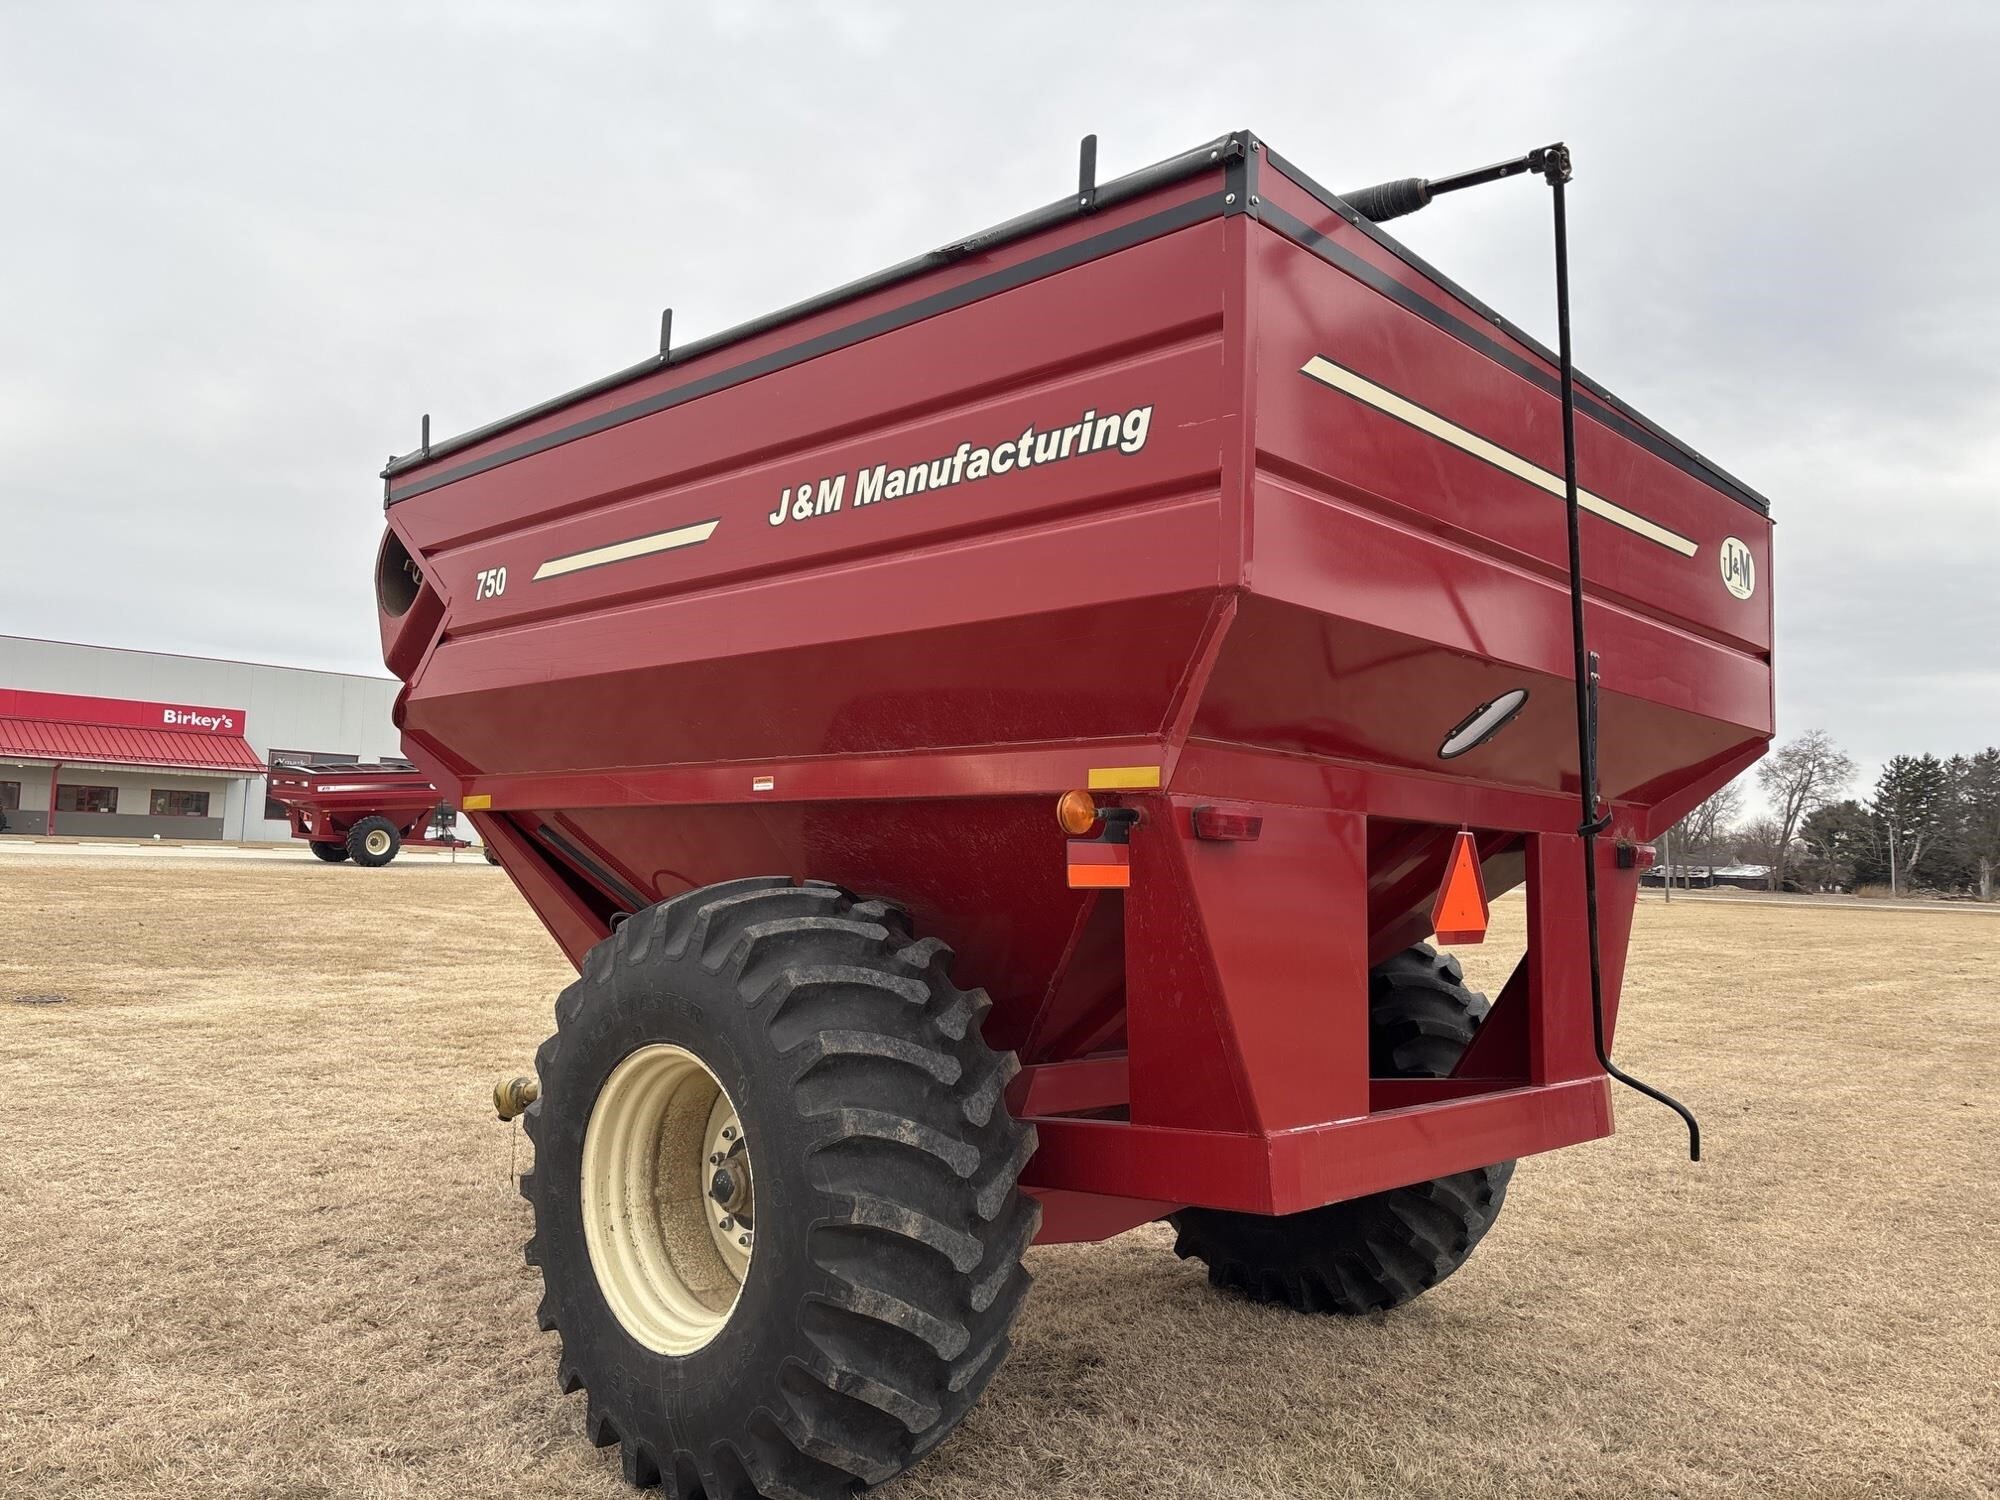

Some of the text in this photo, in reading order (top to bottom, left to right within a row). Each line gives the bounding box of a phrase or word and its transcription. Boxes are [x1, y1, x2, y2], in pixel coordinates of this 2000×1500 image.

[769, 404, 1154, 527] J&M Manufacturing
[475, 566, 507, 601] 750
[1723, 543, 1751, 591] J&M
[163, 709, 233, 731] Birkey's
